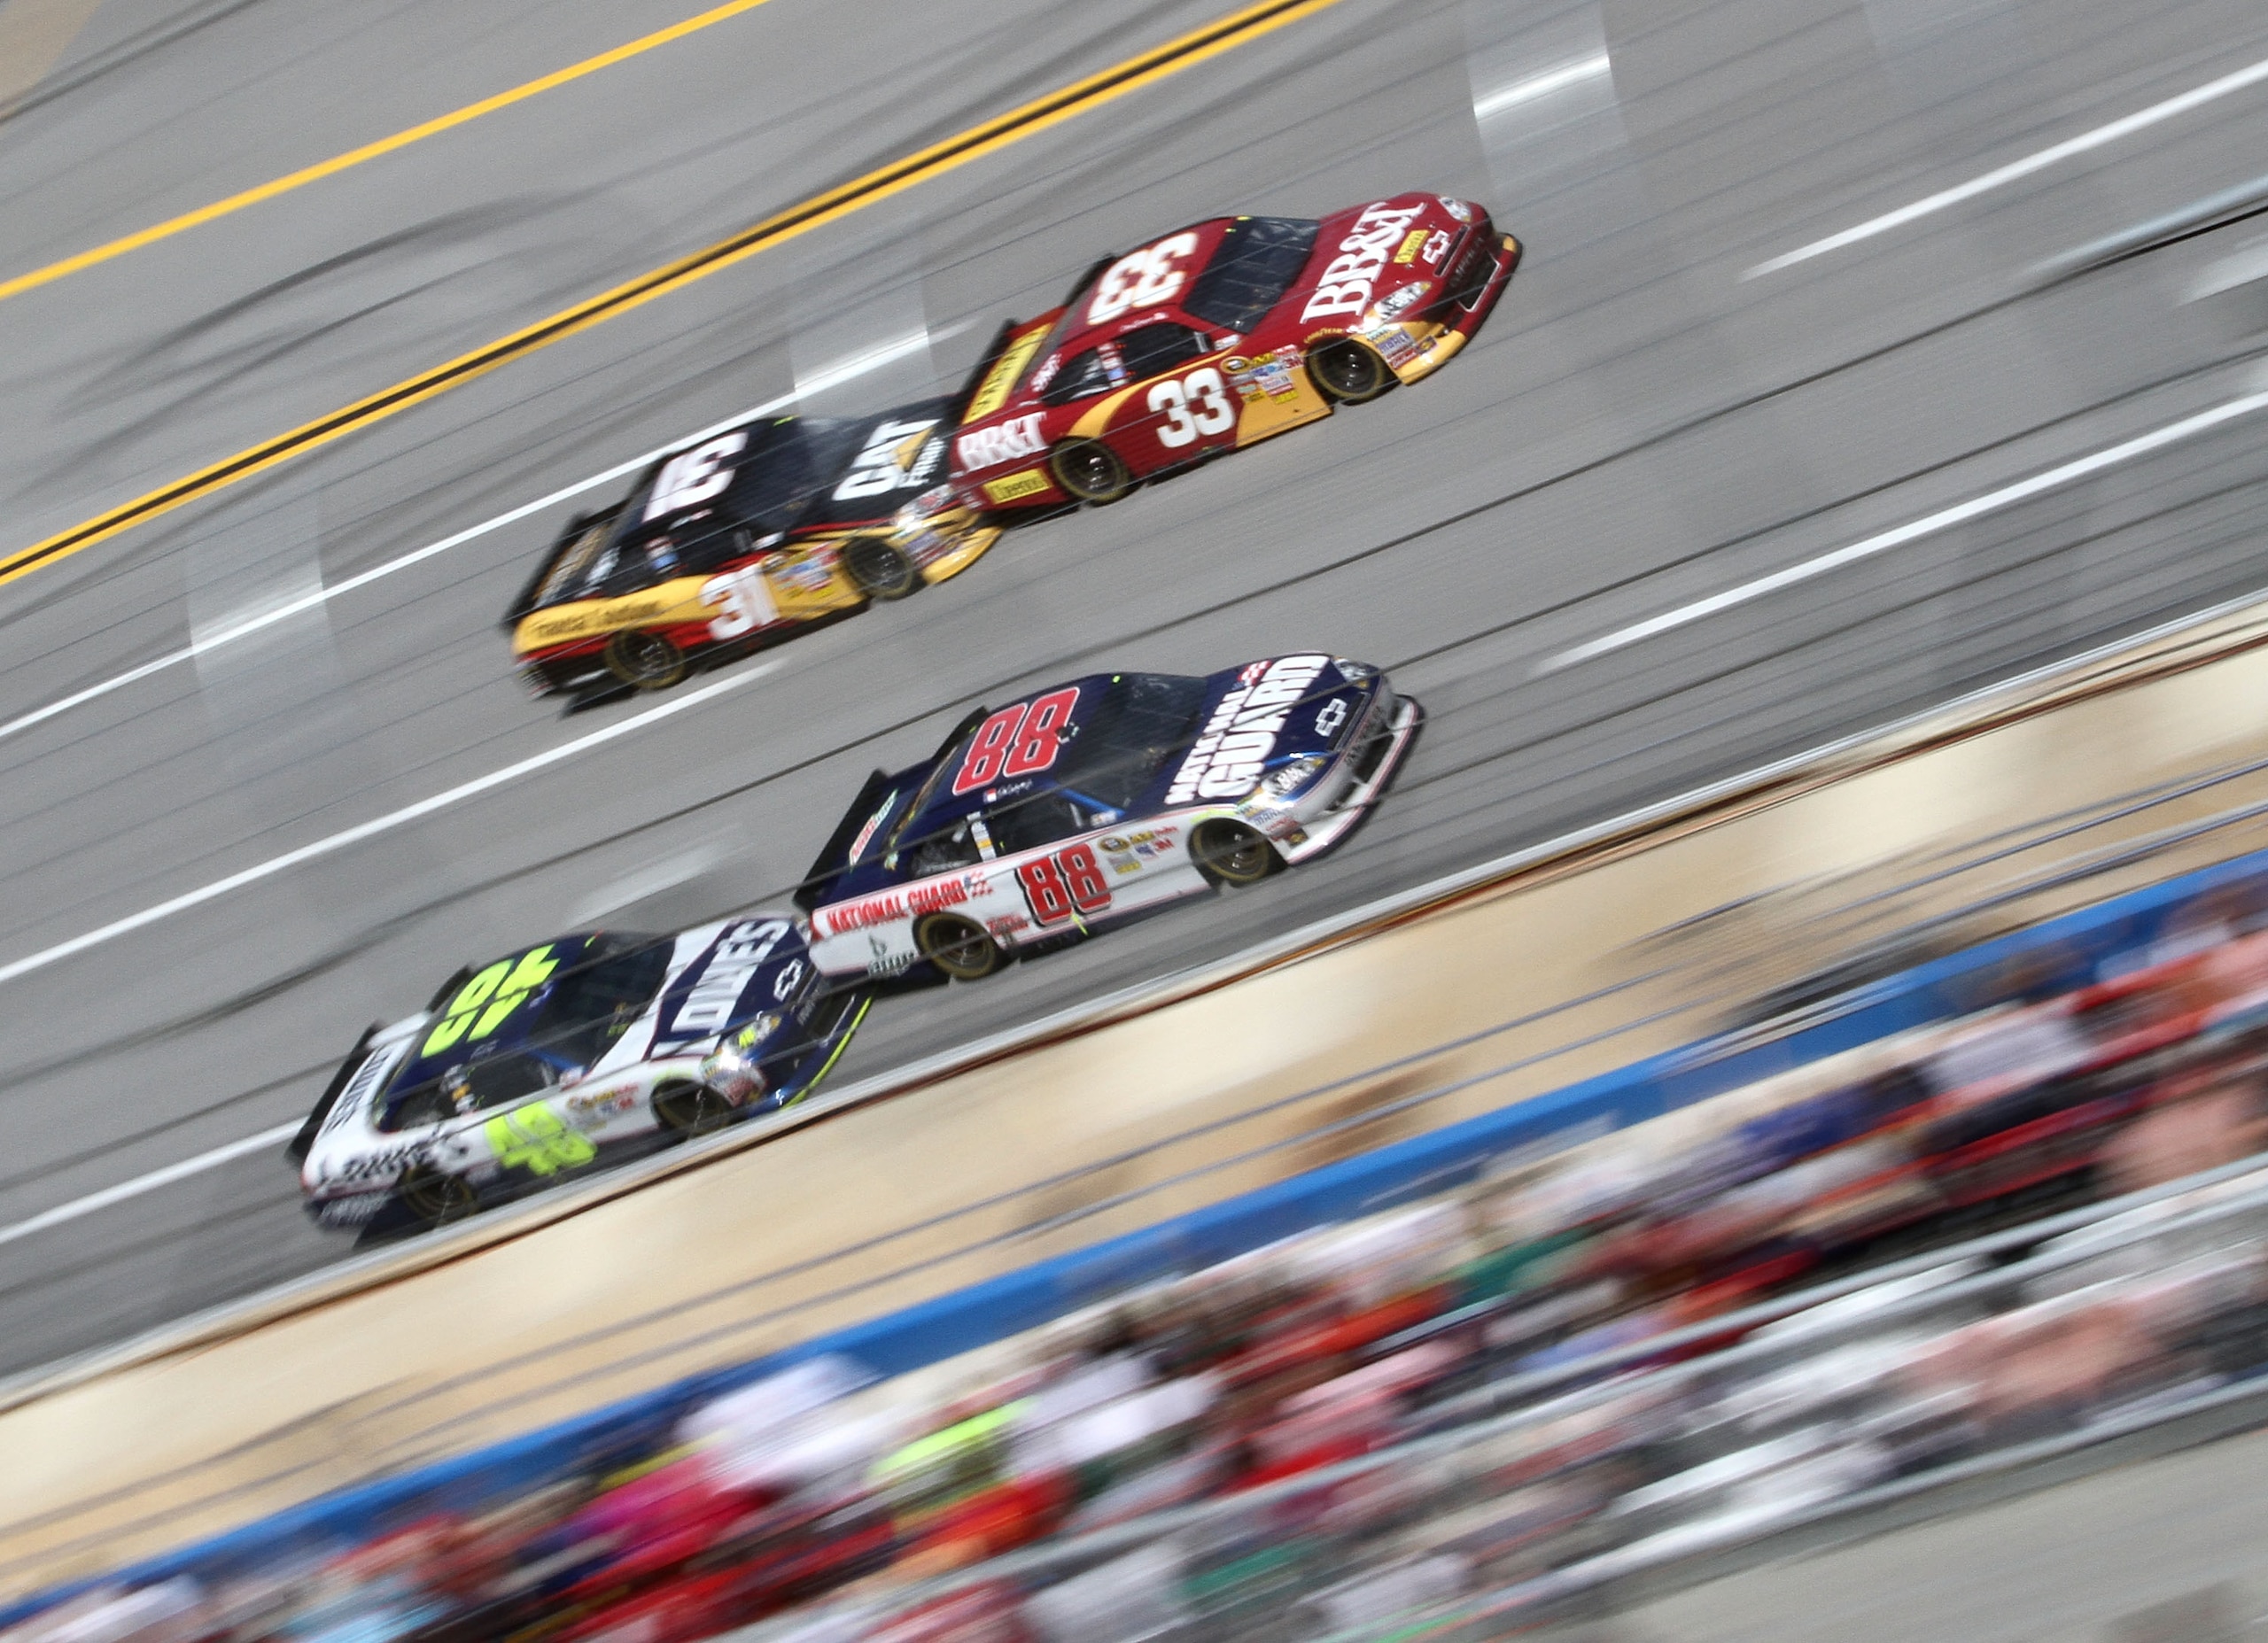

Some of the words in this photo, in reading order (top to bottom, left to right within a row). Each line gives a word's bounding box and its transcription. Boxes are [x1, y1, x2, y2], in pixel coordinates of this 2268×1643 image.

[1087, 232, 1199, 326] 33
[1299, 201, 1429, 325] BB&T
[957, 410, 1049, 473] BB&T
[1146, 368, 1237, 448] 33
[641, 431, 748, 523] 31
[832, 419, 942, 501] CAT
[701, 562, 780, 640] 31
[952, 686, 1081, 796] 88
[1163, 686, 1254, 805] NATIONAL
[1198, 655, 1330, 798] GUARD
[827, 894, 909, 934] NATIONAL
[906, 878, 968, 918] GUARD
[1014, 842, 1113, 927] 88
[421, 943, 561, 1059] 48
[485, 1098, 597, 1176] 48
